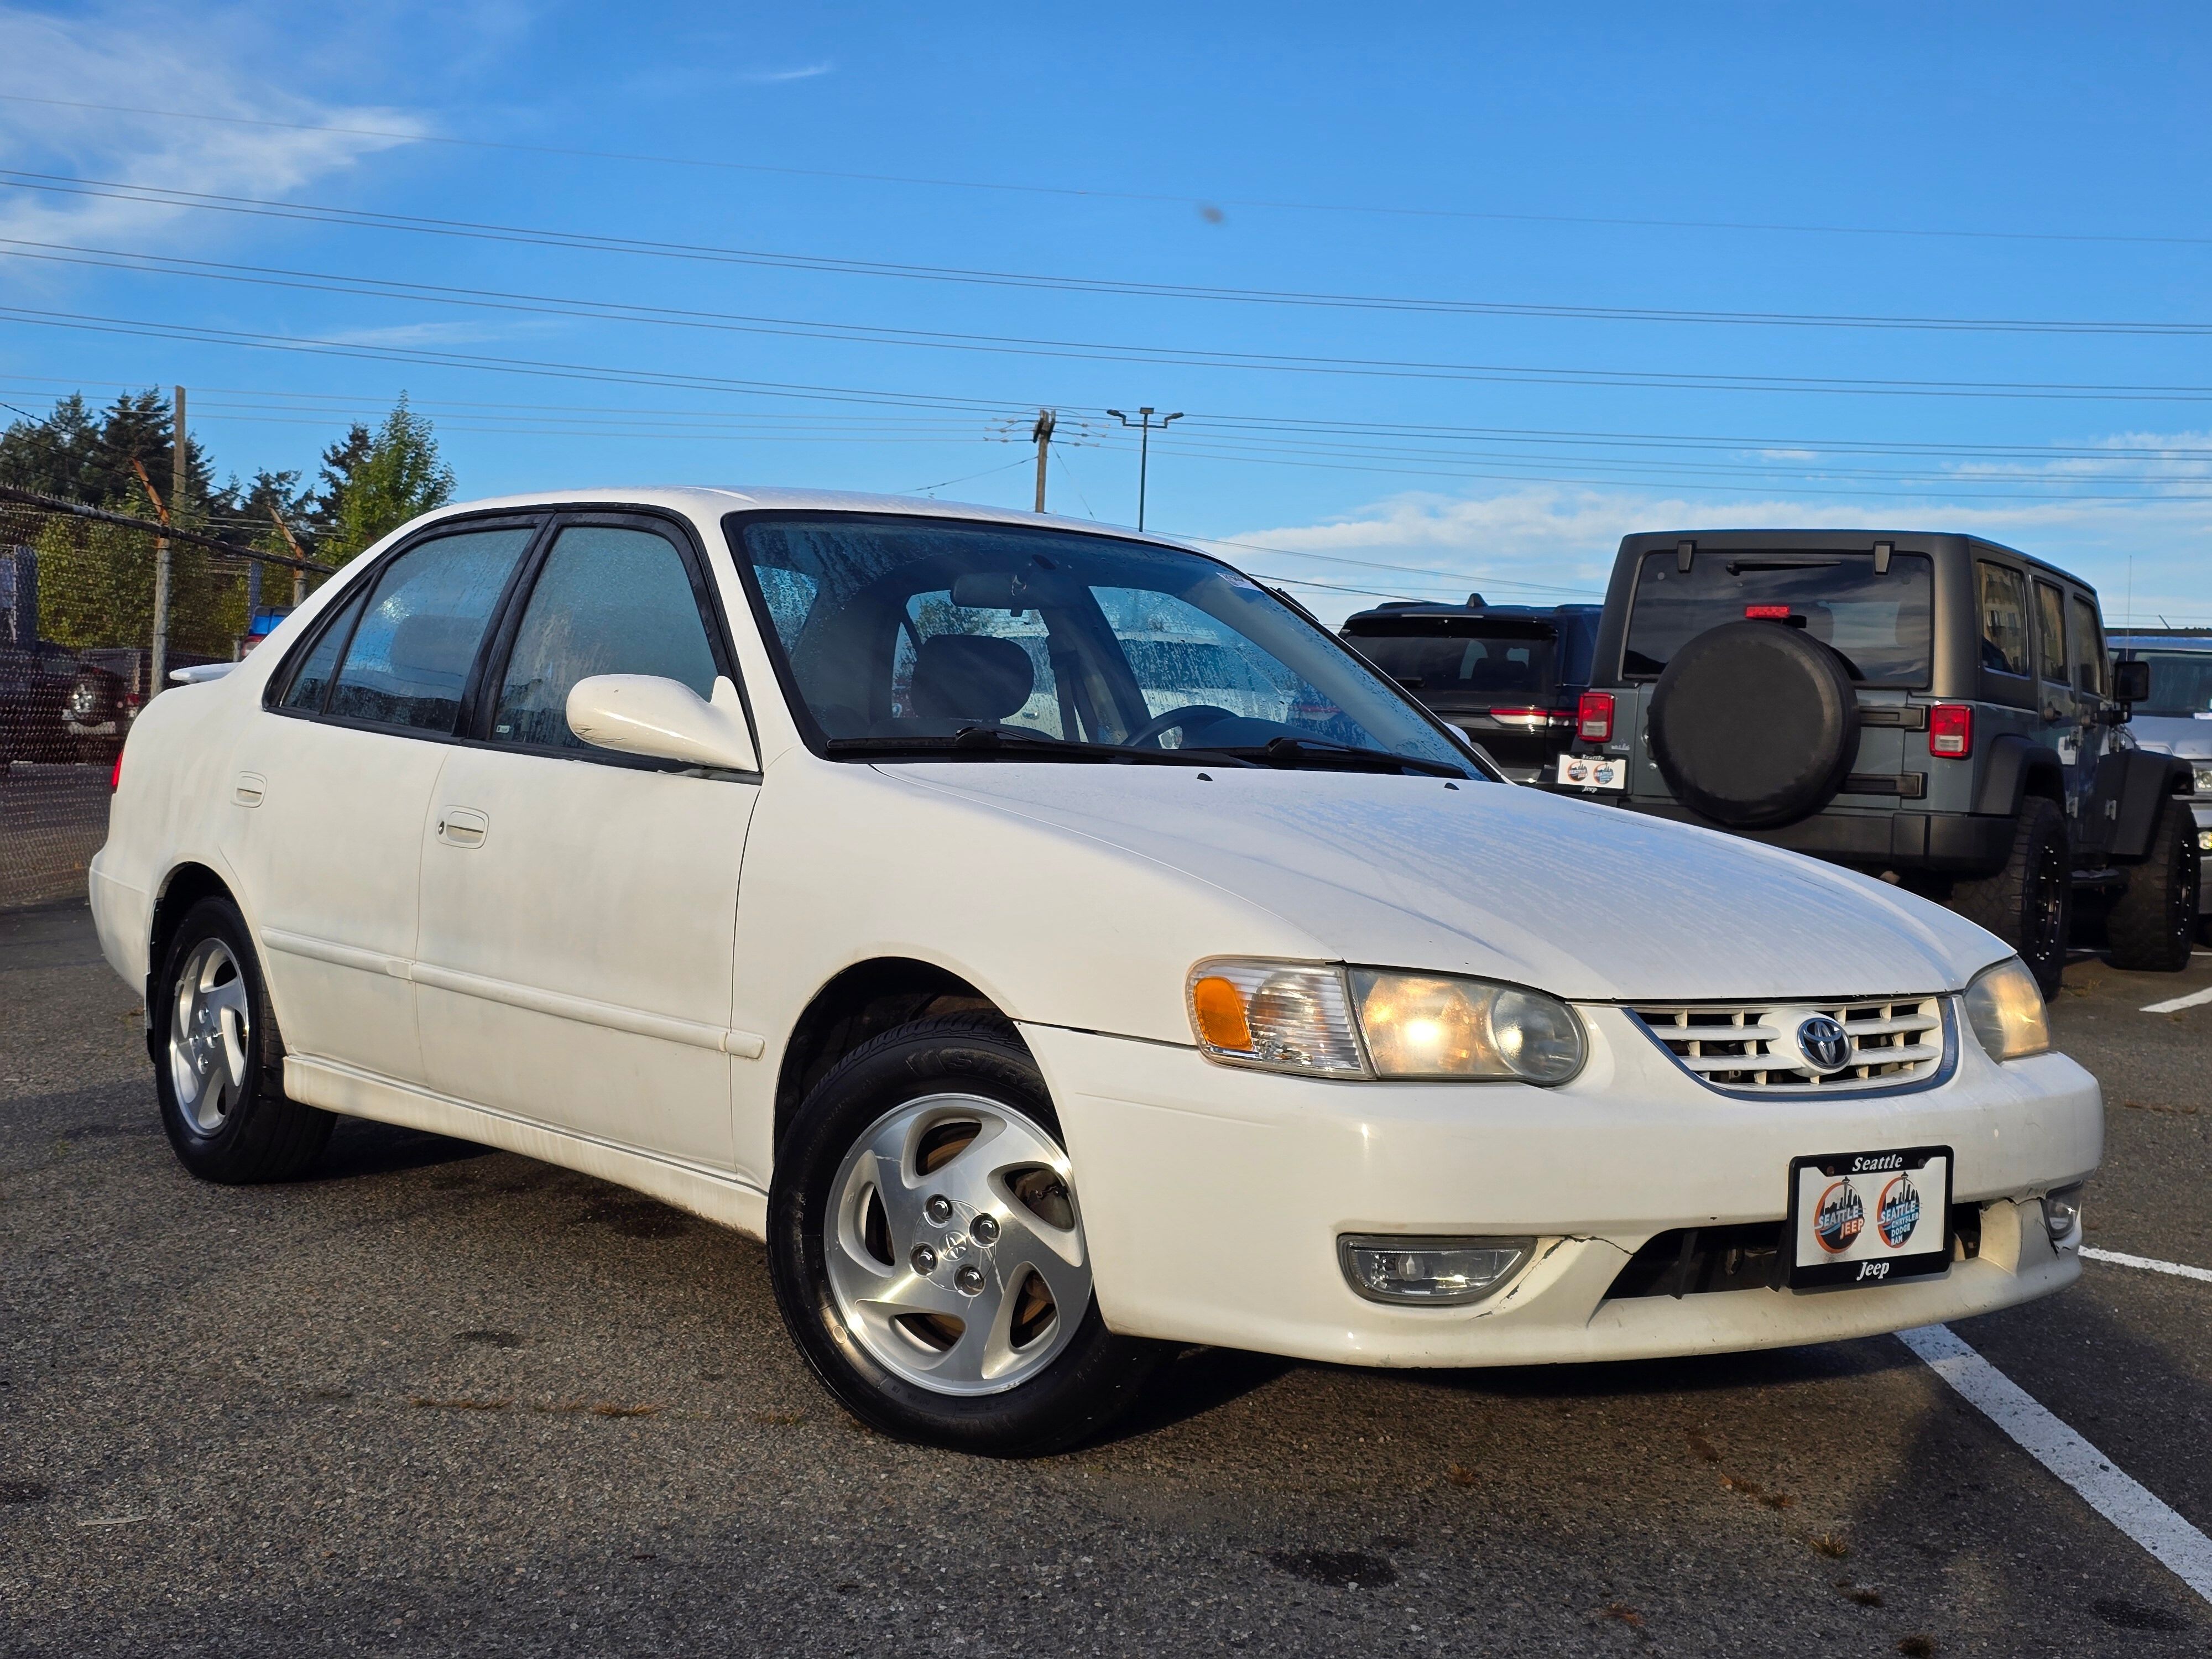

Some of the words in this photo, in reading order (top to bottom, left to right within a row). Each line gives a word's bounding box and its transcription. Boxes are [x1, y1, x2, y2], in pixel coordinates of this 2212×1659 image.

[1852, 1154, 1903, 1172] Seattle
[1818, 1205, 1859, 1227] SEATTLE
[1881, 1200, 1916, 1223] SEATTLE
[1891, 1213, 1919, 1228] CHRYSLER
[1840, 1218, 1864, 1240] JEEP
[1891, 1223, 1911, 1237] DODGE
[1891, 1235, 1903, 1246] RAM
[1856, 1261, 1890, 1281] Jeep
